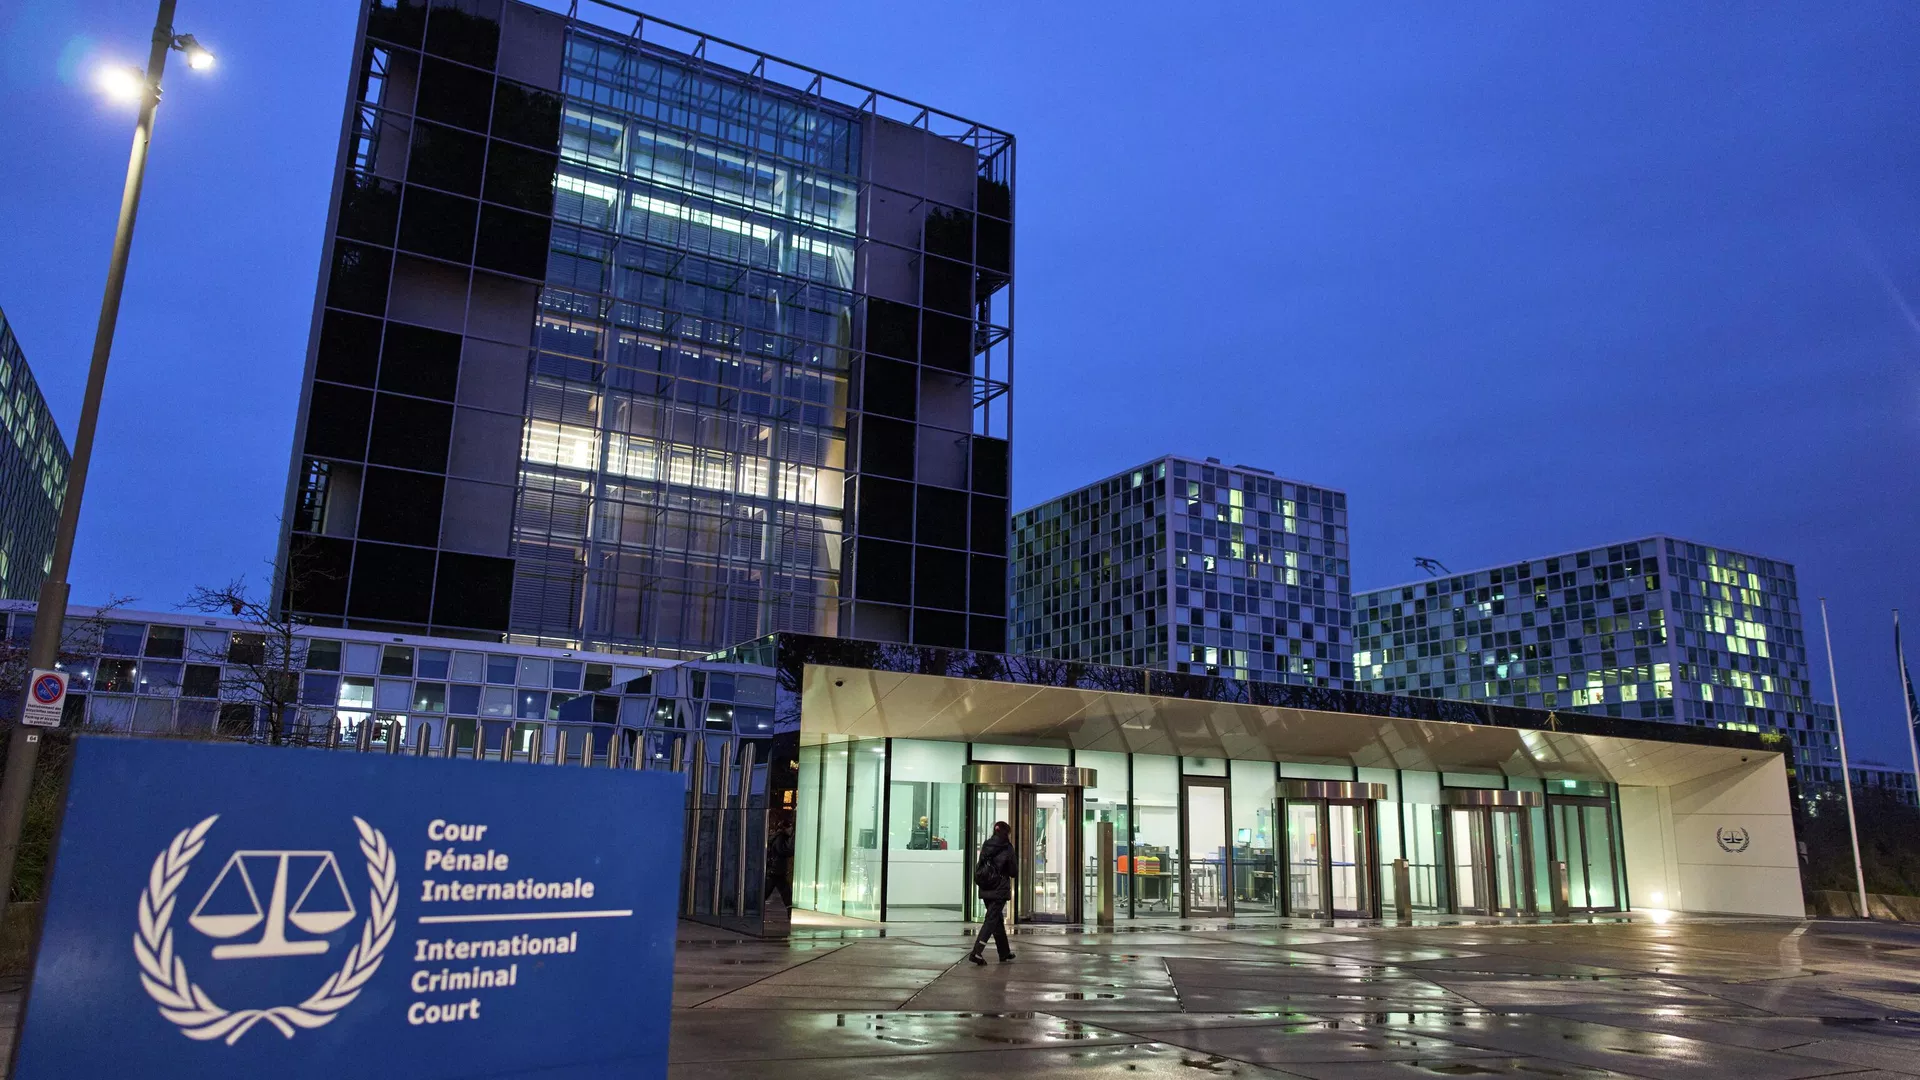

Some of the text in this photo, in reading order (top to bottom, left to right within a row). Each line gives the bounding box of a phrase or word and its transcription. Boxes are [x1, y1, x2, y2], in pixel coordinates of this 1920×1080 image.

[428, 819, 488, 842] Cour
[424, 847, 509, 872] Pénale
[420, 877, 595, 902] Internationale
[413, 931, 578, 962] International
[410, 964, 518, 993] Criminal
[407, 998, 481, 1025] Court
